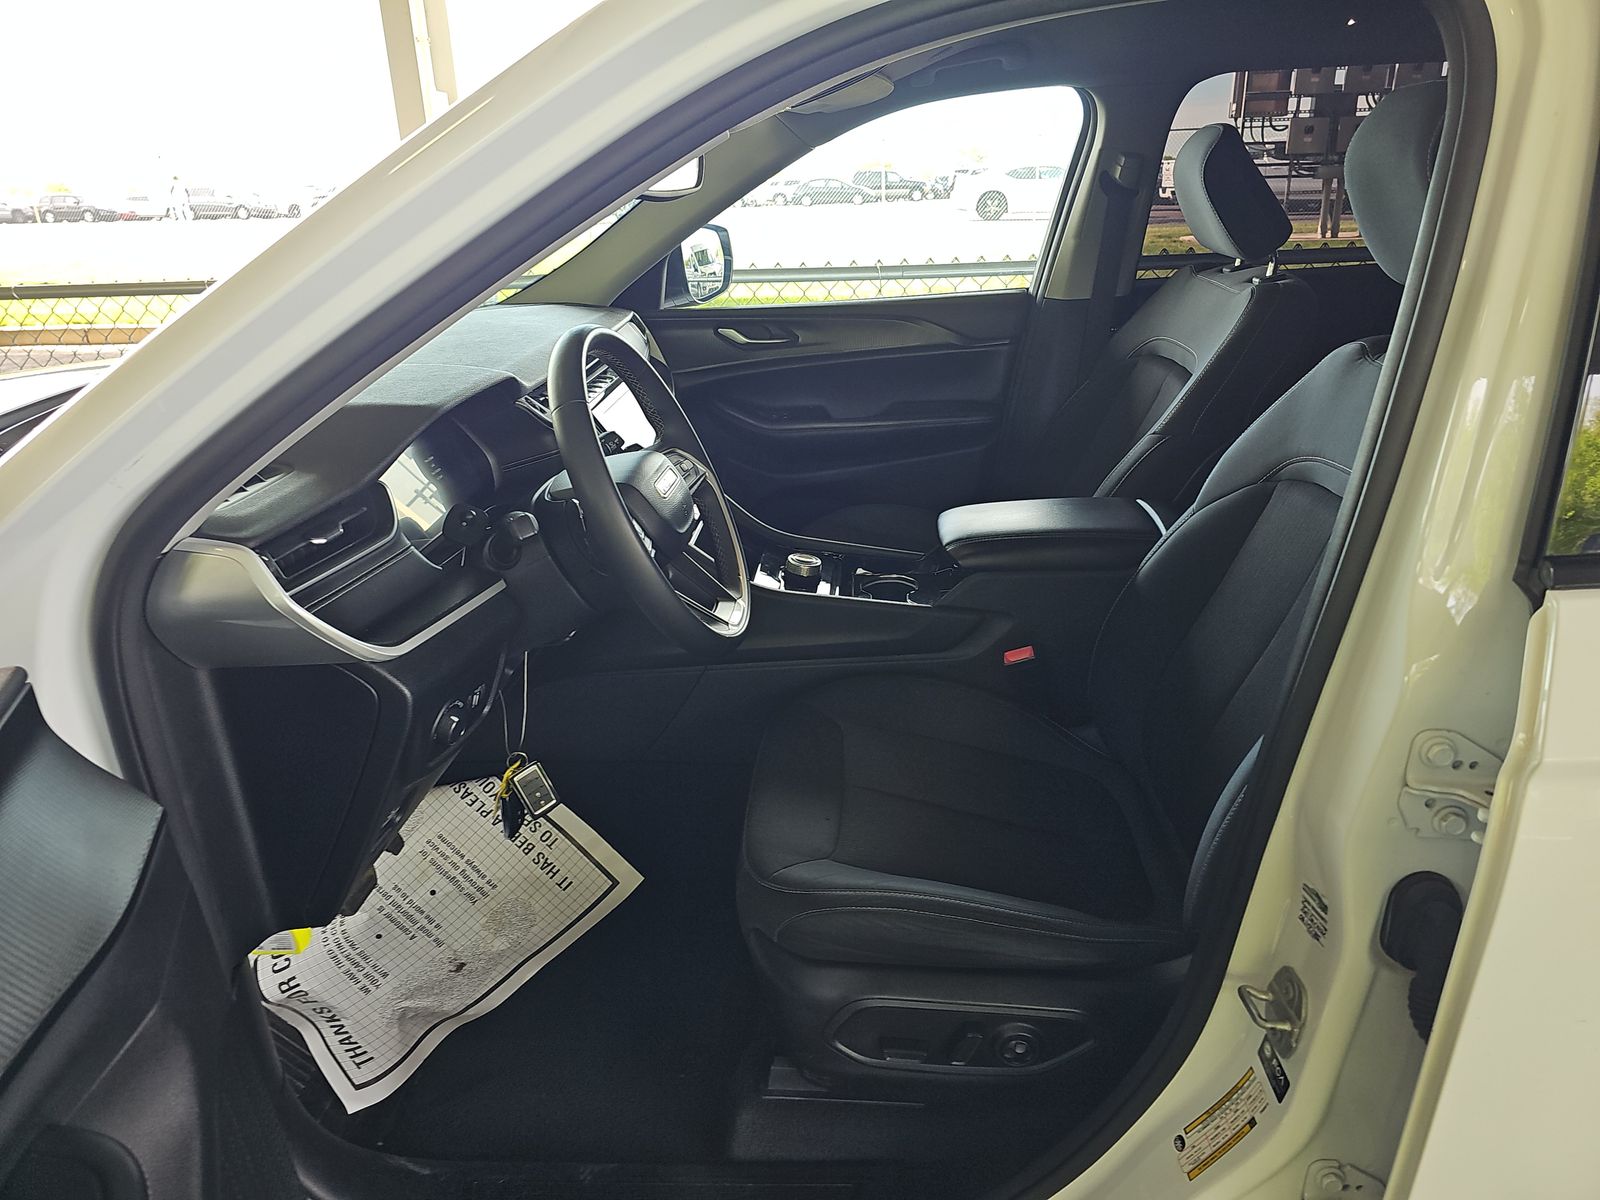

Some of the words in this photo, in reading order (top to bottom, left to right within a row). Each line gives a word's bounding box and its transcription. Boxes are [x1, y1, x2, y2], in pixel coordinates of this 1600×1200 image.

[450, 782, 493, 818] PLEAS
[425, 837, 450, 860] service
[500, 830, 535, 855] BEE
[539, 830, 559, 850] TO
[419, 847, 430, 860] for
[448, 859, 461, 871] our
[464, 857, 489, 879] always
[531, 850, 561, 880] HAS
[428, 856, 466, 892] suggestions
[459, 868, 490, 899] improving
[486, 878, 499, 890] are
[555, 875, 574, 891] IT
[400, 891, 408, 901] to
[463, 891, 478, 905] Your
[376, 904, 386, 913] is
[388, 898, 418, 927] important
[405, 898, 425, 915] world
[382, 911, 412, 936] customer
[424, 913, 435, 925] the
[433, 922, 442, 931] in
[341, 928, 360, 951] PAPER
[416, 924, 434, 938] most
[322, 935, 330, 947] TO
[432, 936, 444, 948] the
[326, 948, 345, 969] TRIED
[333, 936, 365, 972] CARPETING
[356, 949, 373, 963] THIS
[341, 968, 361, 985] HAVE
[361, 970, 382, 988] YOUR
[370, 962, 389, 979] WITH
[279, 975, 319, 1004] FOR
[357, 983, 371, 995] WE
[311, 1007, 374, 1069] THANKS
